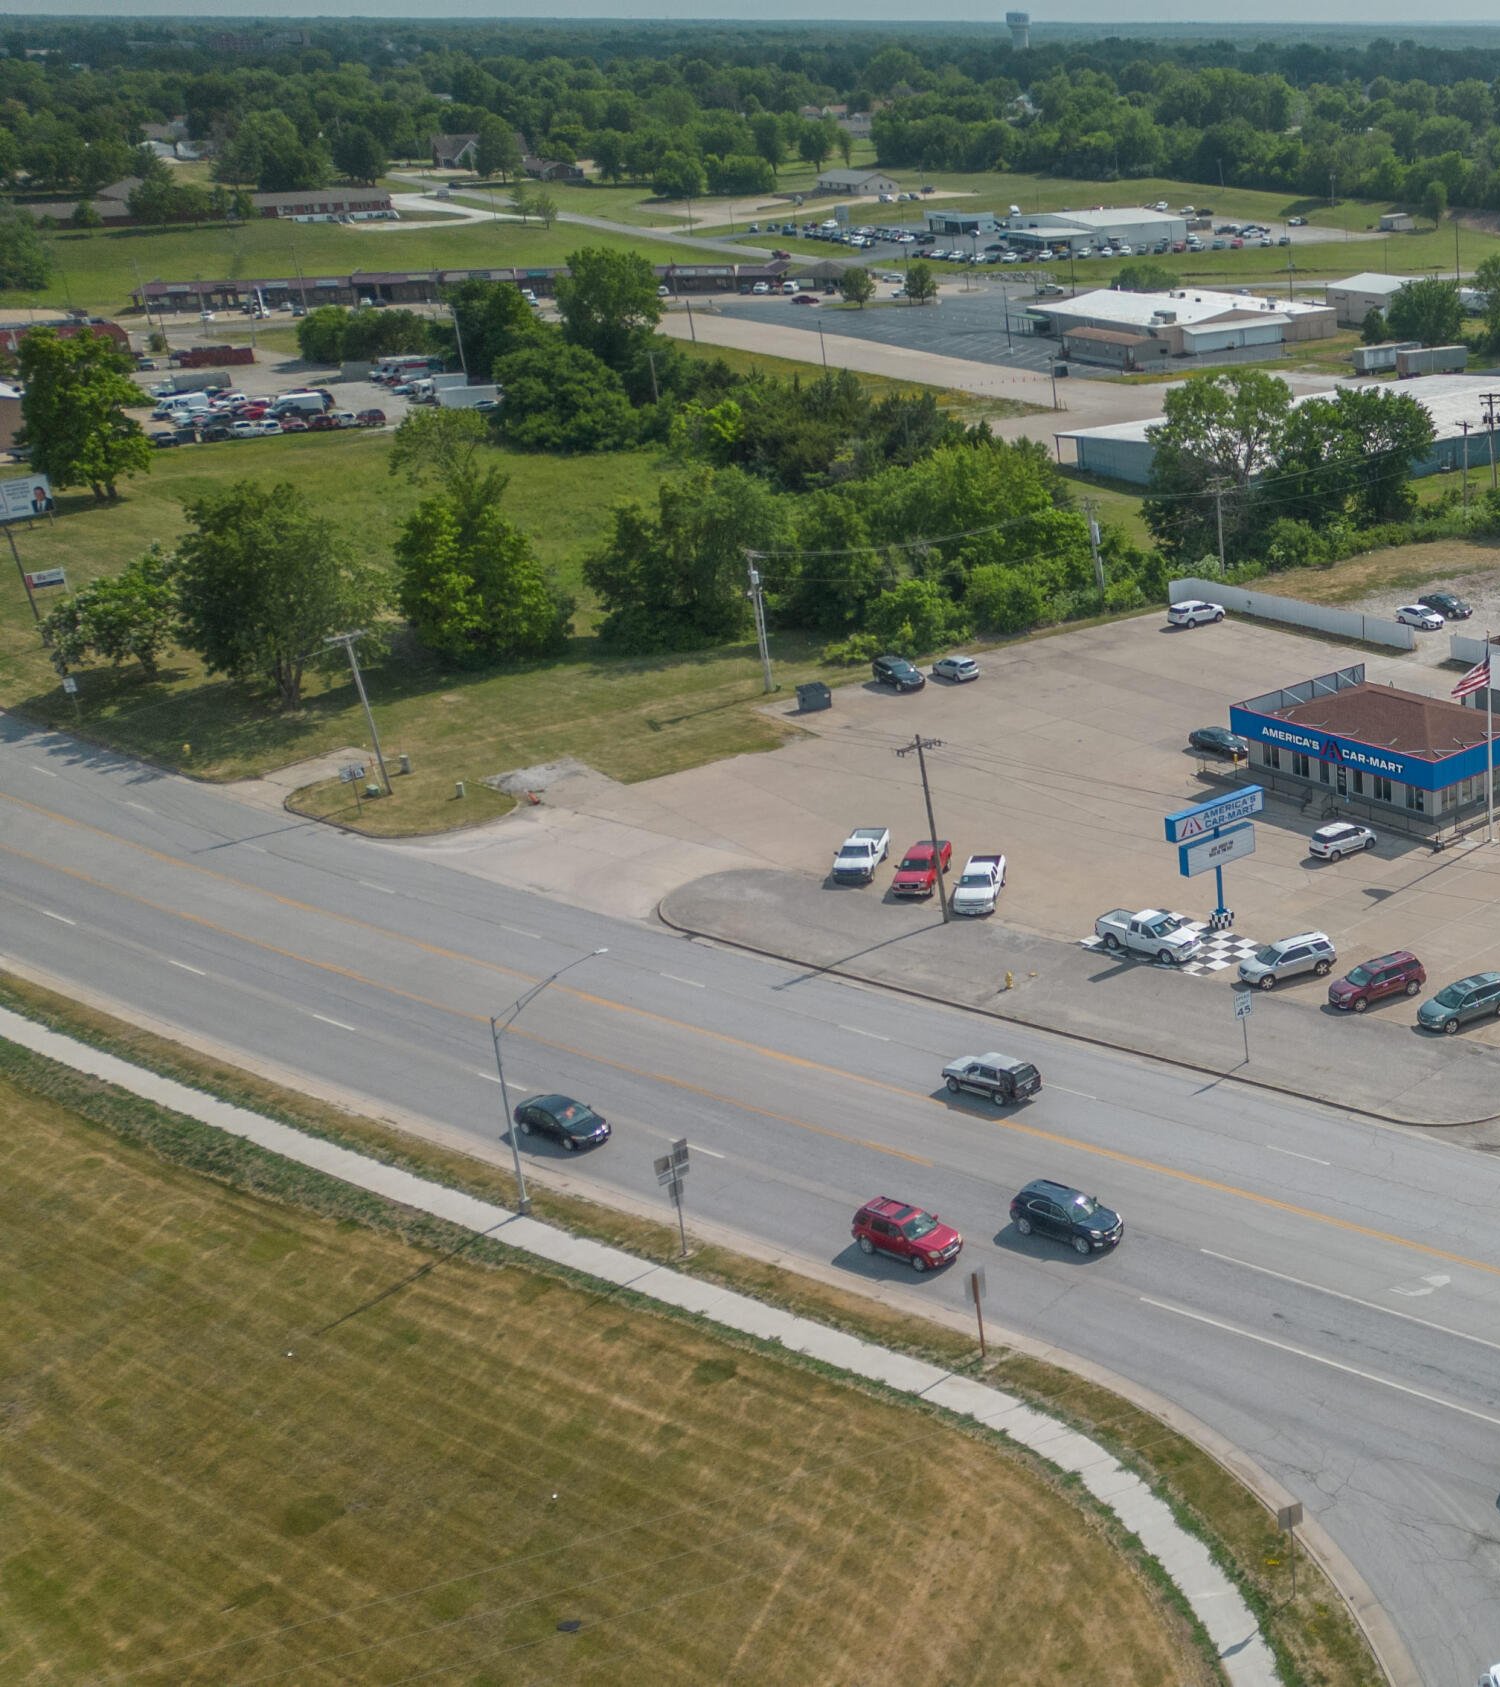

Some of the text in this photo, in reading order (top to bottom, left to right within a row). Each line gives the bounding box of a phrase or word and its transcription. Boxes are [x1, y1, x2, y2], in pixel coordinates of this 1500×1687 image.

[1262, 726, 1404, 774] AMERICA'S CAR-MART
[1203, 794, 1257, 820] AMERICA'S
[1204, 804, 1255, 829] CAR-MART
[1237, 1005, 1251, 1016] 45
